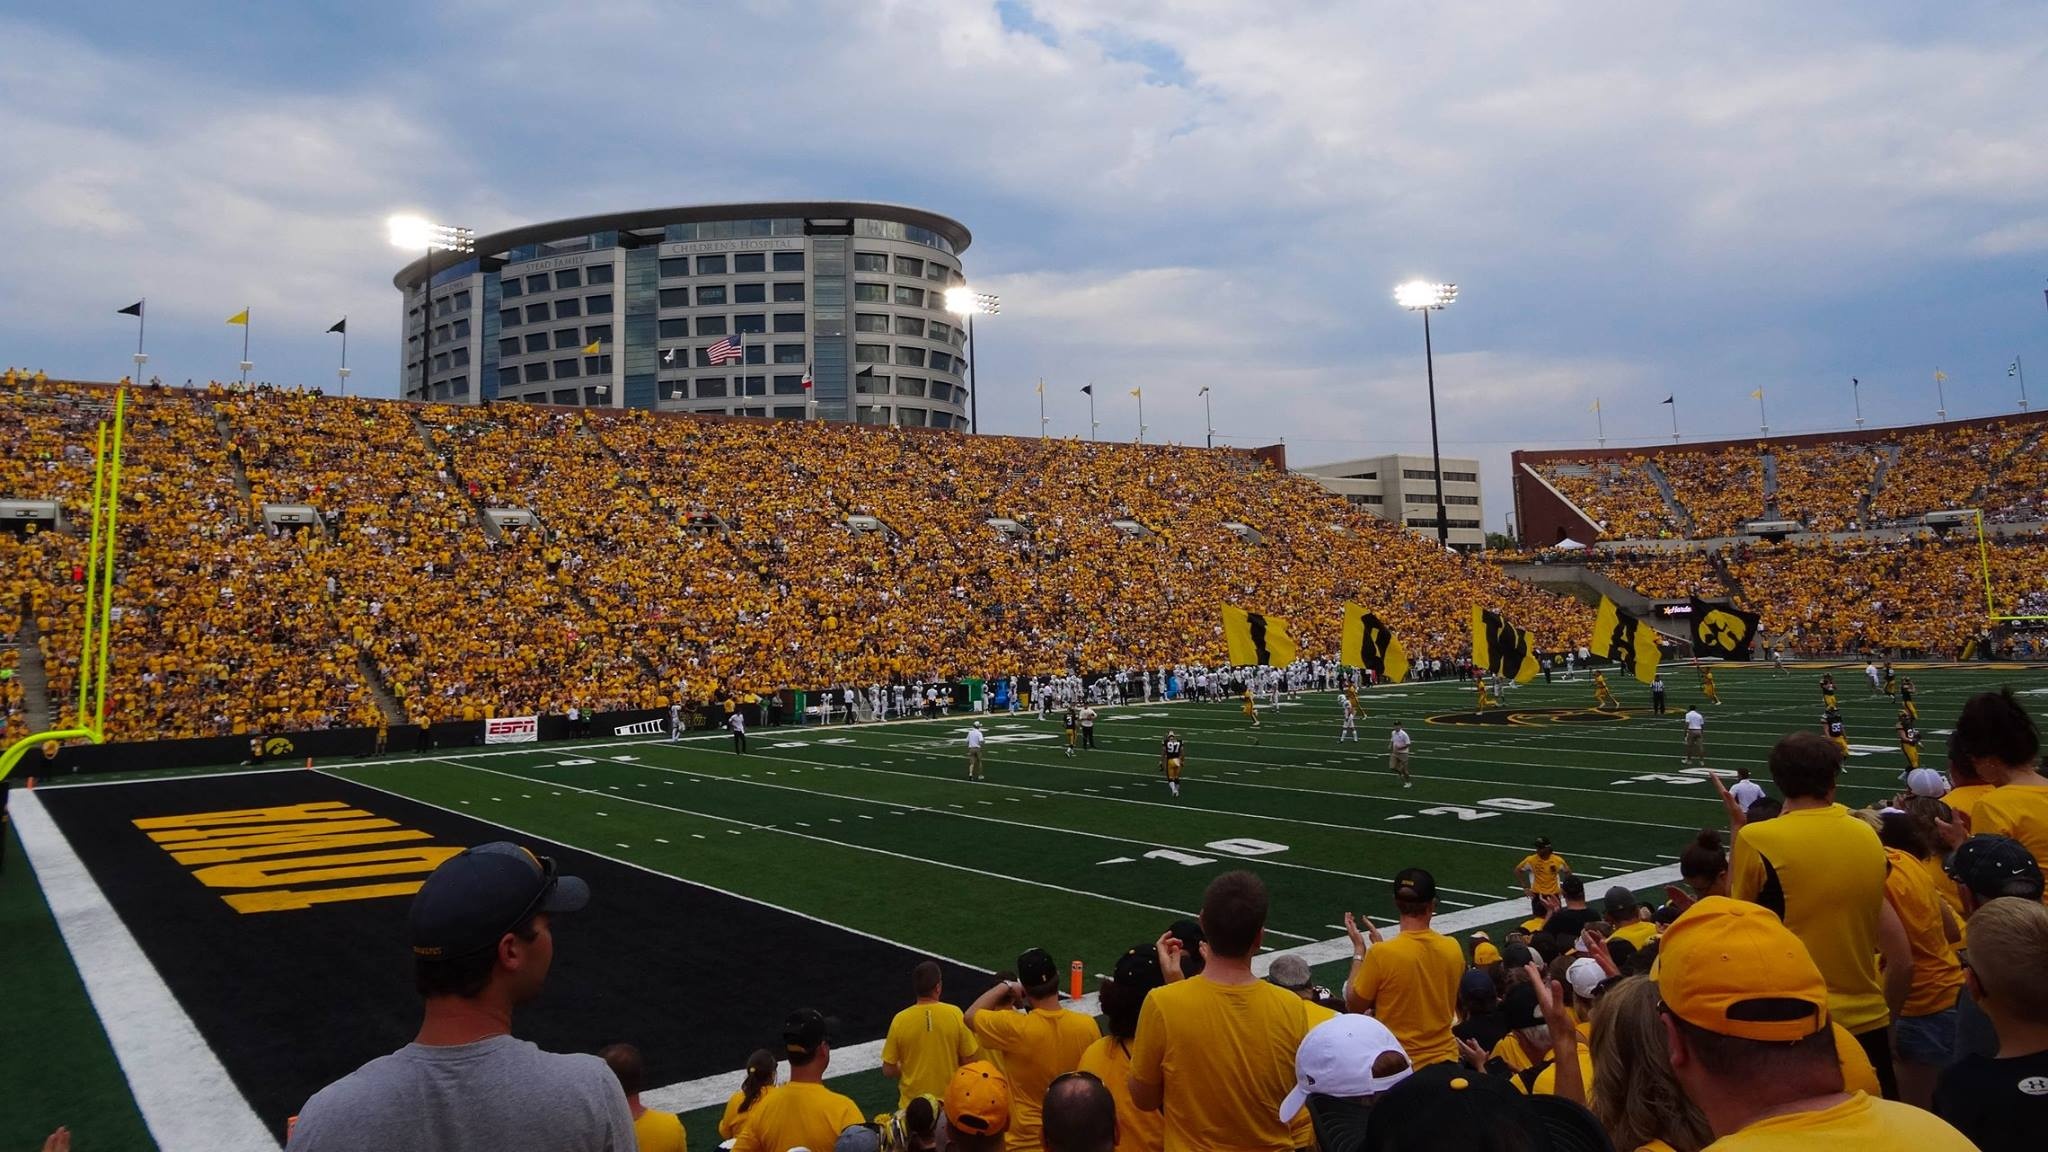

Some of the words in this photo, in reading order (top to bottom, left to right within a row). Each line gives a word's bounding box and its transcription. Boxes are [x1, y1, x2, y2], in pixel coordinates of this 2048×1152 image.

[672, 241, 736, 253] CHILDREN'S
[740, 239, 792, 249] HOSPITAL
[526, 261, 551, 271] STEAD
[553, 255, 584, 267] FAMILY
[489, 720, 535, 735] ESPN
[1167, 741, 1181, 753] 97
[1418, 797, 1554, 820] 20
[1143, 837, 1288, 866] 10
